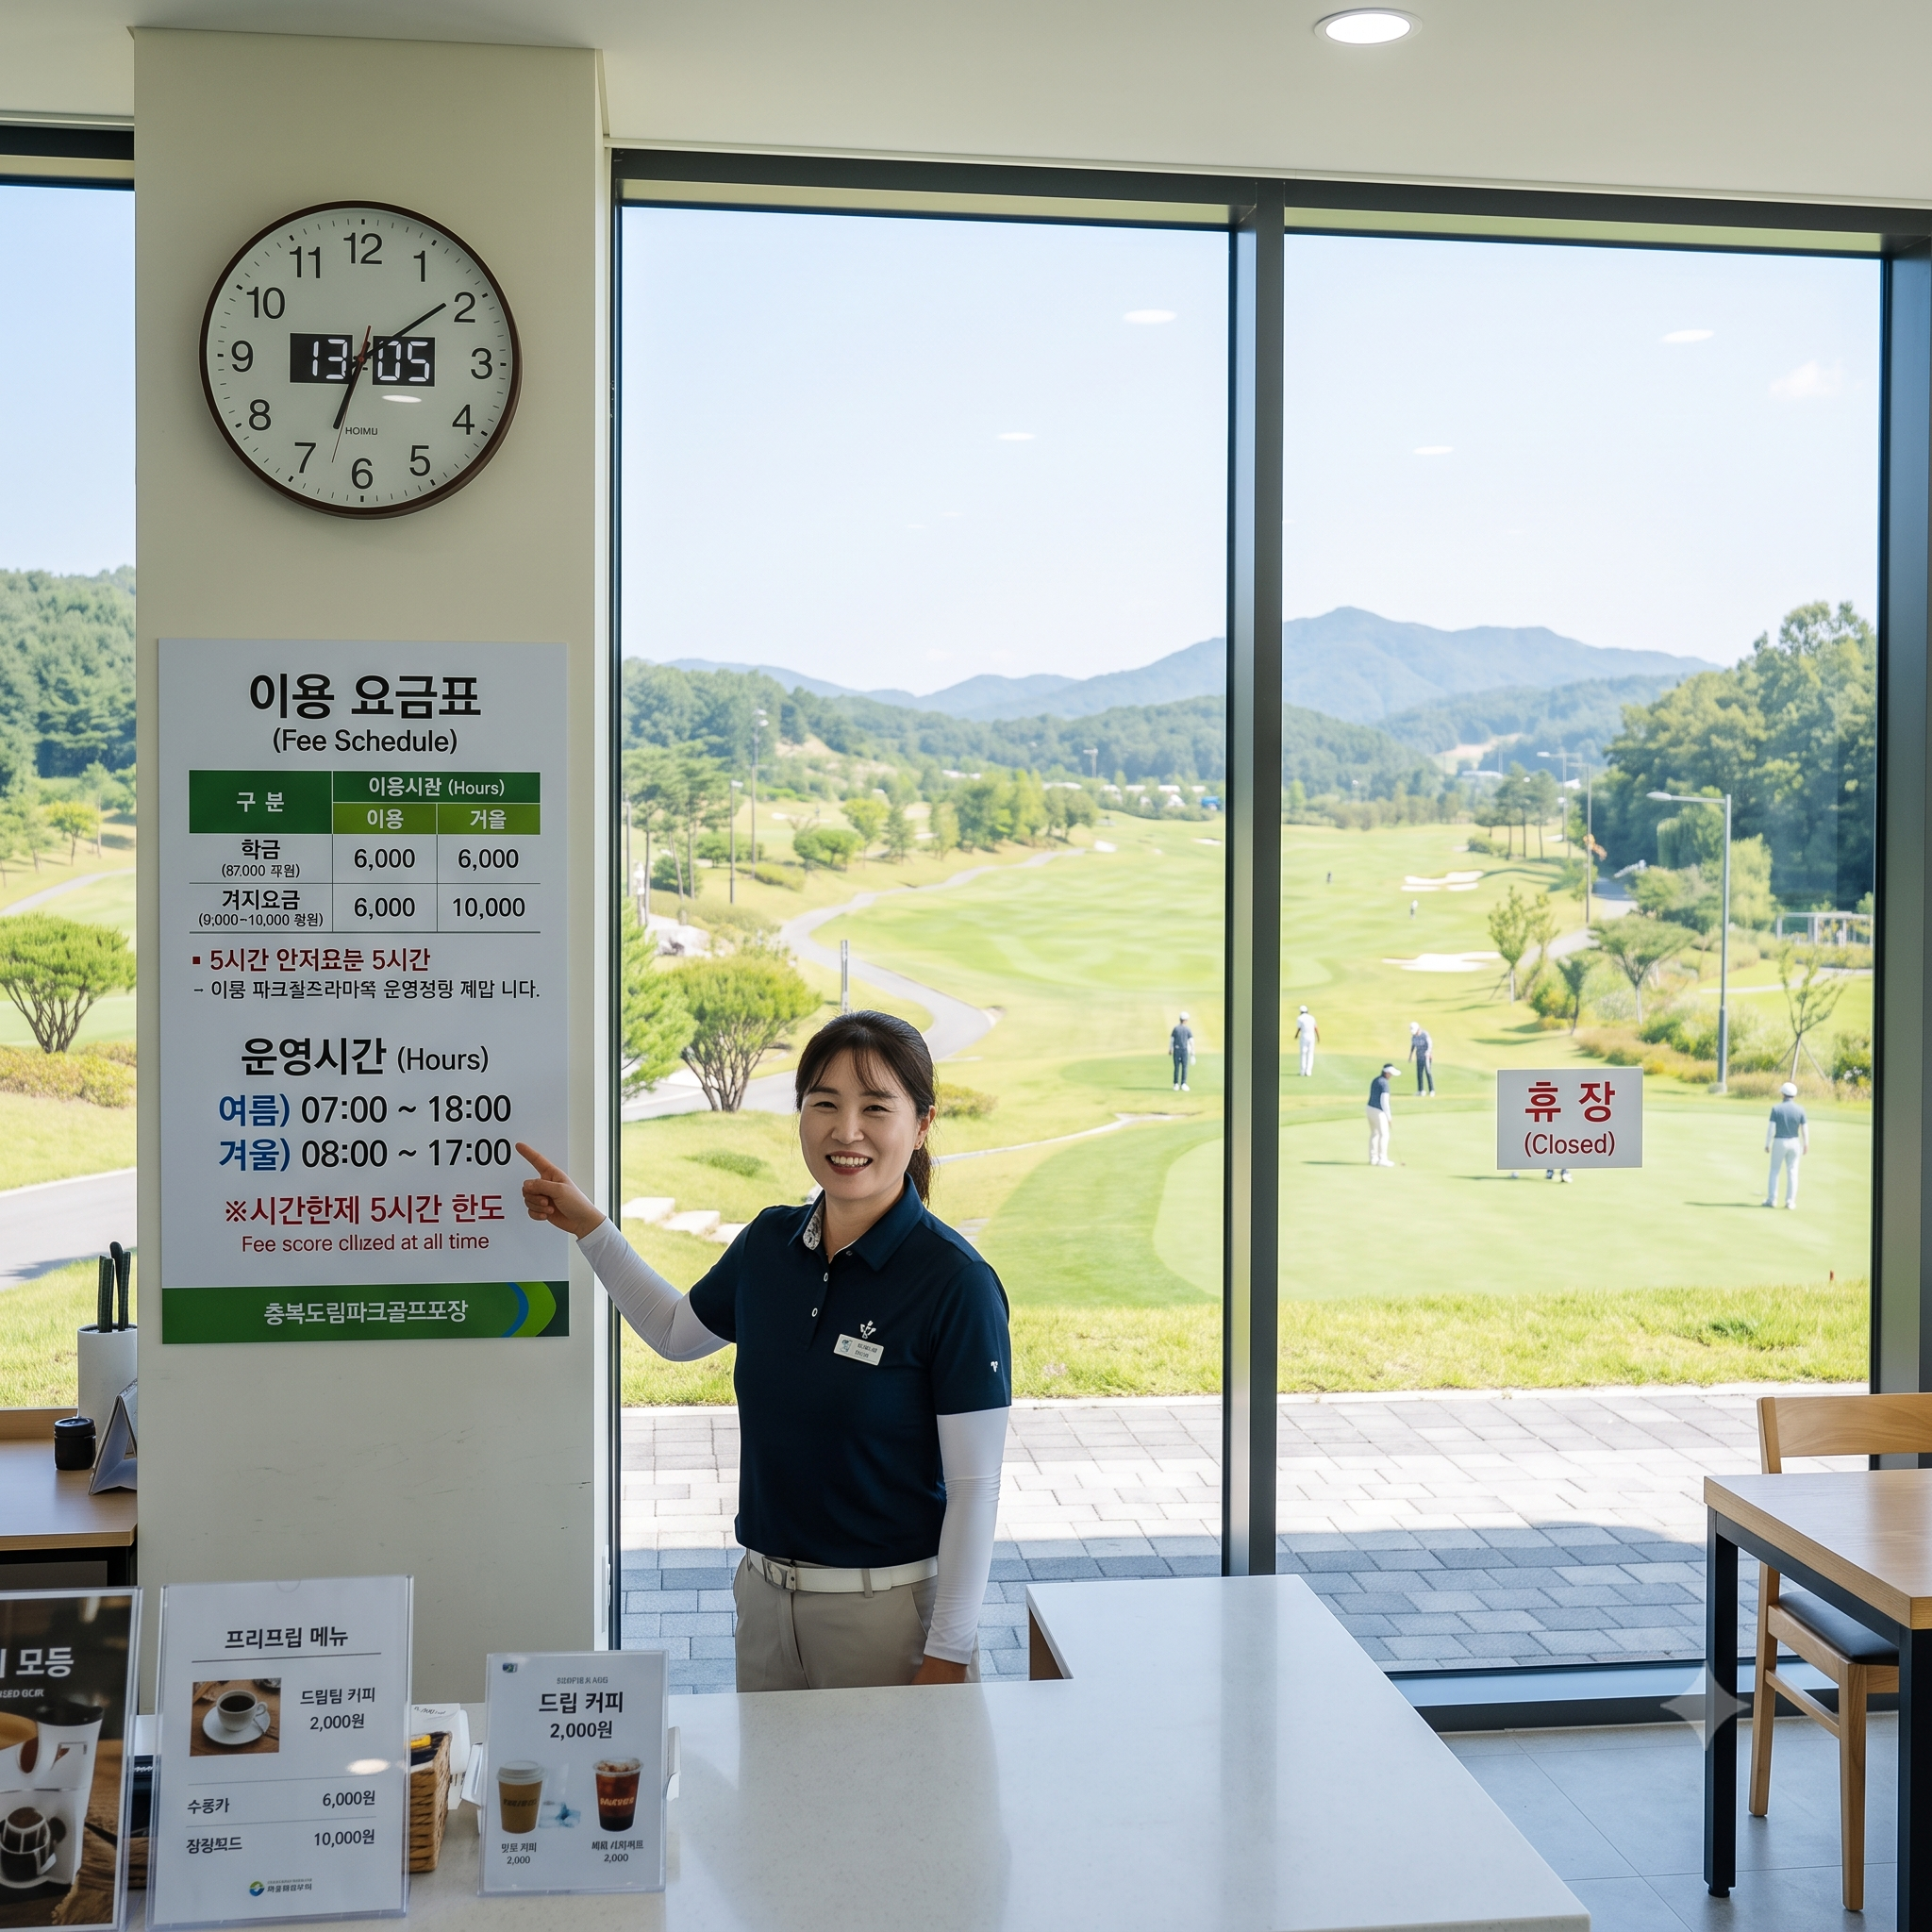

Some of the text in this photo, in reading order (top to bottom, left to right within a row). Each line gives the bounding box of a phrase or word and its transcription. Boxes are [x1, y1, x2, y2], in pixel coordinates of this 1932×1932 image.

[343, 232, 383, 265] 12
[289, 246, 321, 278] 11
[413, 250, 426, 282] 1
[246, 287, 286, 319] 10
[454, 291, 475, 323] 2
[231, 340, 254, 372] 9
[471, 347, 493, 379] 3
[248, 399, 272, 431] 8
[452, 404, 475, 435] 4
[345, 426, 378, 436] HOIMU
[294, 441, 316, 474] 7
[409, 444, 431, 476] 5
[351, 458, 374, 490] 6
[249, 673, 482, 721] 이용 요금표
[273, 727, 458, 755] (Fee Schedule)
[448, 779, 505, 797] (Hours)
[367, 808, 404, 829] 이용
[242, 839, 280, 860] 학금
[354, 849, 416, 871] 6,000
[458, 849, 520, 871] 6,000
[222, 889, 300, 911] 겨지요금
[354, 898, 416, 920] 6,000
[453, 898, 526, 920] 10,000
[210, 948, 270, 972] 5시간
[372, 948, 431, 972] 5시간
[241, 1038, 489, 1076] 운영시간 (Hours)
[219, 1093, 290, 1127] 여름)
[302, 1095, 388, 1124] 07:00
[428, 1094, 511, 1123] 18:00
[219, 1138, 291, 1172] 겨울)
[302, 1140, 388, 1168] 08:00
[428, 1138, 511, 1166] 17:00
[1524, 1131, 1615, 1158] (Closed)
[371, 1194, 442, 1224] 5시간
[452, 1193, 505, 1223] 한도
[242, 1236, 276, 1253] Fee
[282, 1238, 333, 1252] score
[401, 1235, 418, 1250] at
[424, 1233, 442, 1250] all
[449, 1233, 490, 1249] time
[310, 1626, 348, 1647] 메뉴
[16, 1647, 75, 1677] 모등
[347, 1687, 375, 1703] 커피
[539, 1691, 624, 1714] 드립 커피
[309, 1713, 365, 1732] 2,000원
[550, 1721, 613, 1741] 2,000원
[323, 1790, 375, 1808] 6,000원
[314, 1828, 375, 1848] 10,000원
[507, 1856, 531, 1865] 2,000
[604, 1854, 629, 1863] 2,000
